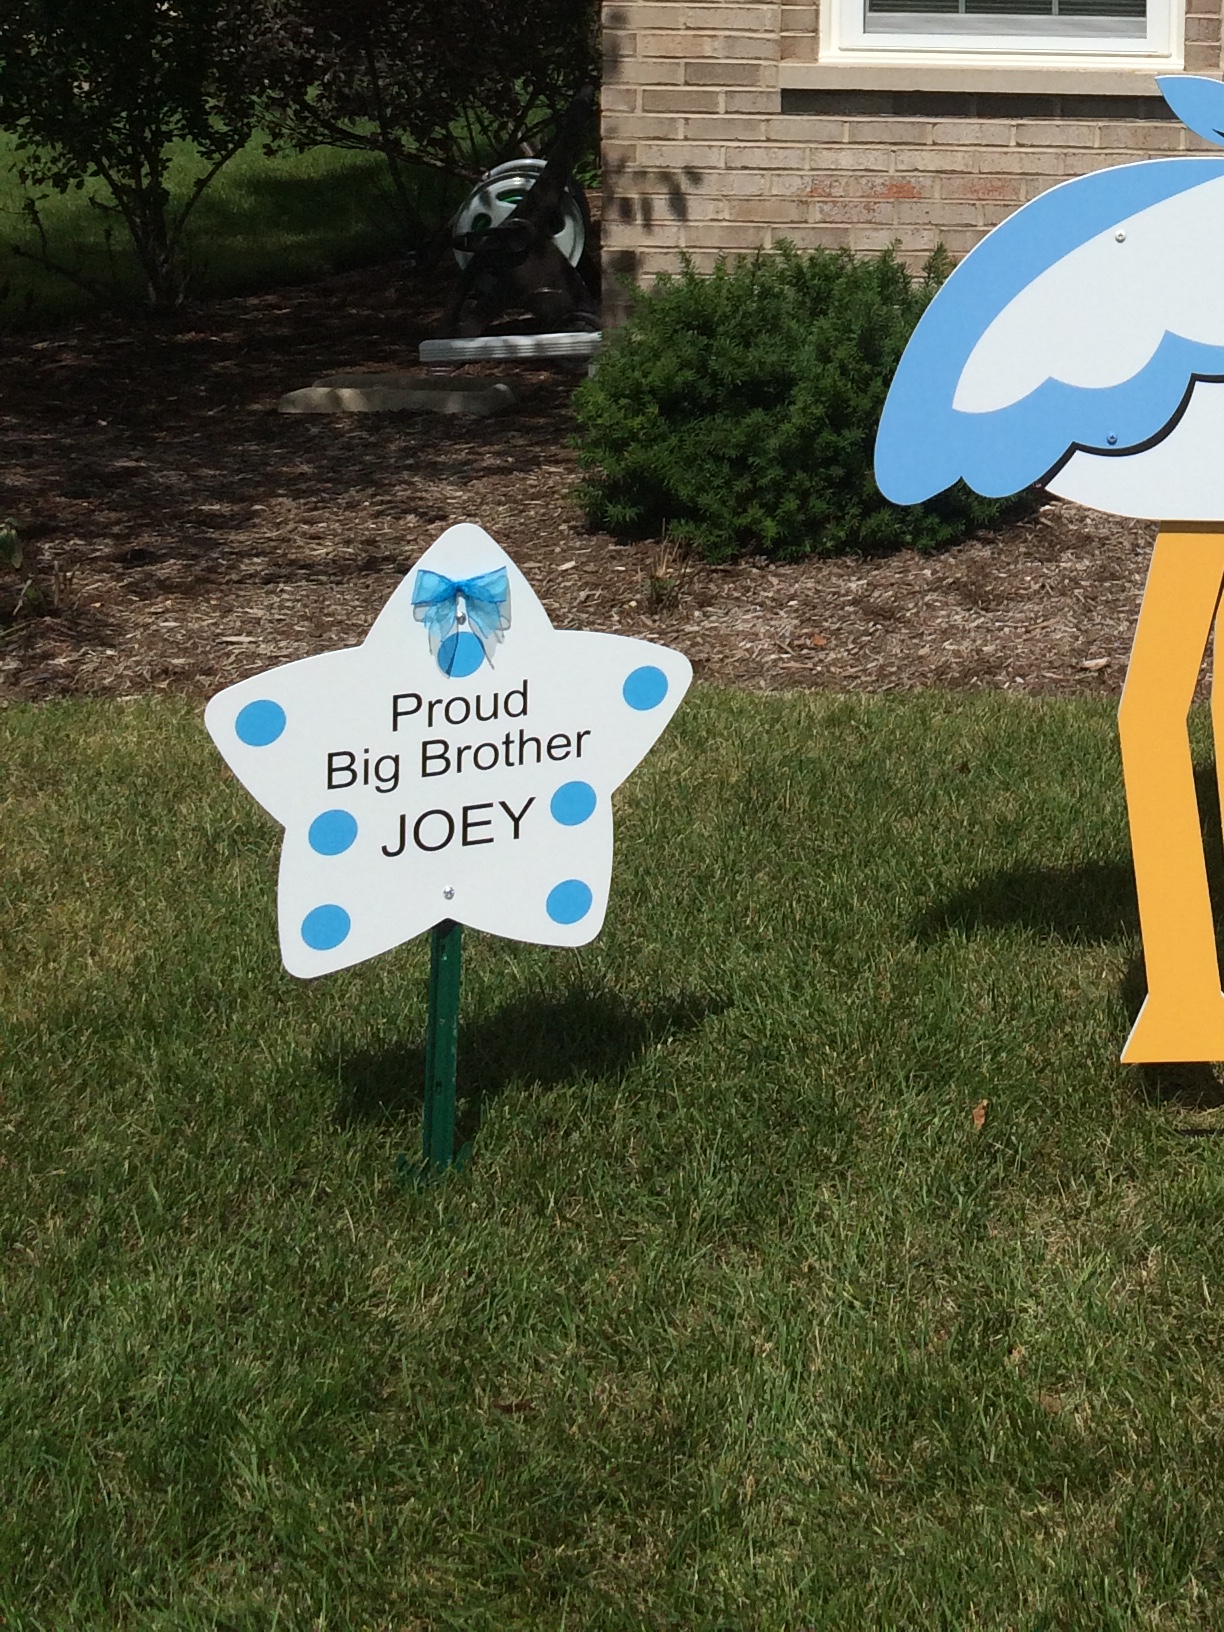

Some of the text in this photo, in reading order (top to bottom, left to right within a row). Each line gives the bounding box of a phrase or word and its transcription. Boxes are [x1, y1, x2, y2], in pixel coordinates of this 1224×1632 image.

[392, 679, 528, 732] Proud
[327, 728, 591, 794] Big Brother
[381, 796, 536, 858] JOEY
